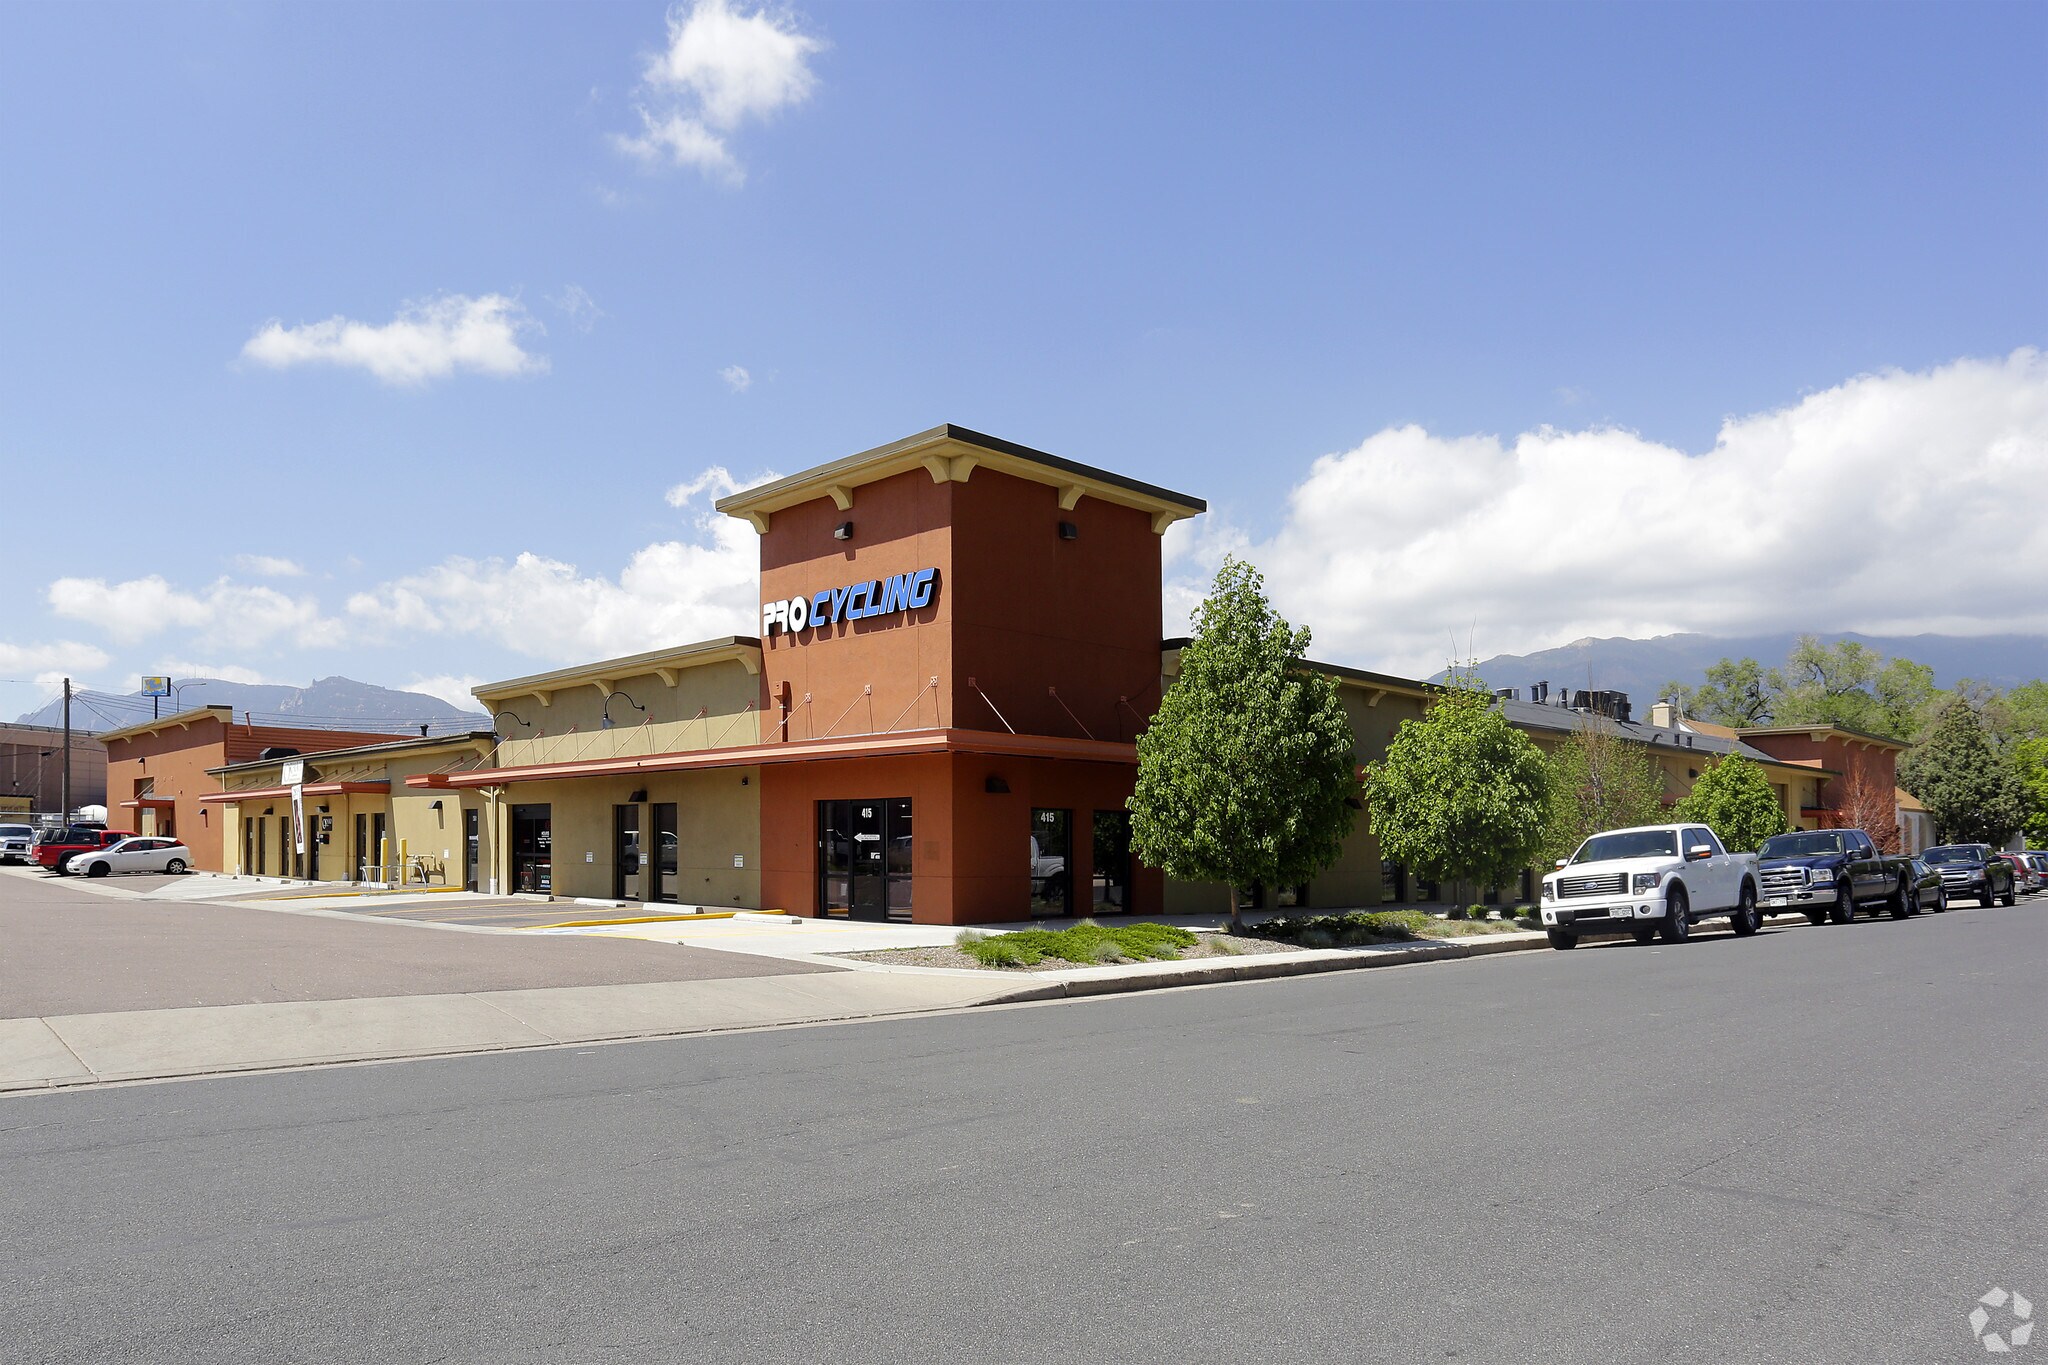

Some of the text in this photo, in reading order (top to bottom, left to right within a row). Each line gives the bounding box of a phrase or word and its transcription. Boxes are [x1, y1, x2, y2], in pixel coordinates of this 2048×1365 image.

[809, 567, 936, 628] CYCLING
[861, 807, 873, 819] 415
[1040, 812, 1055, 823] 415
